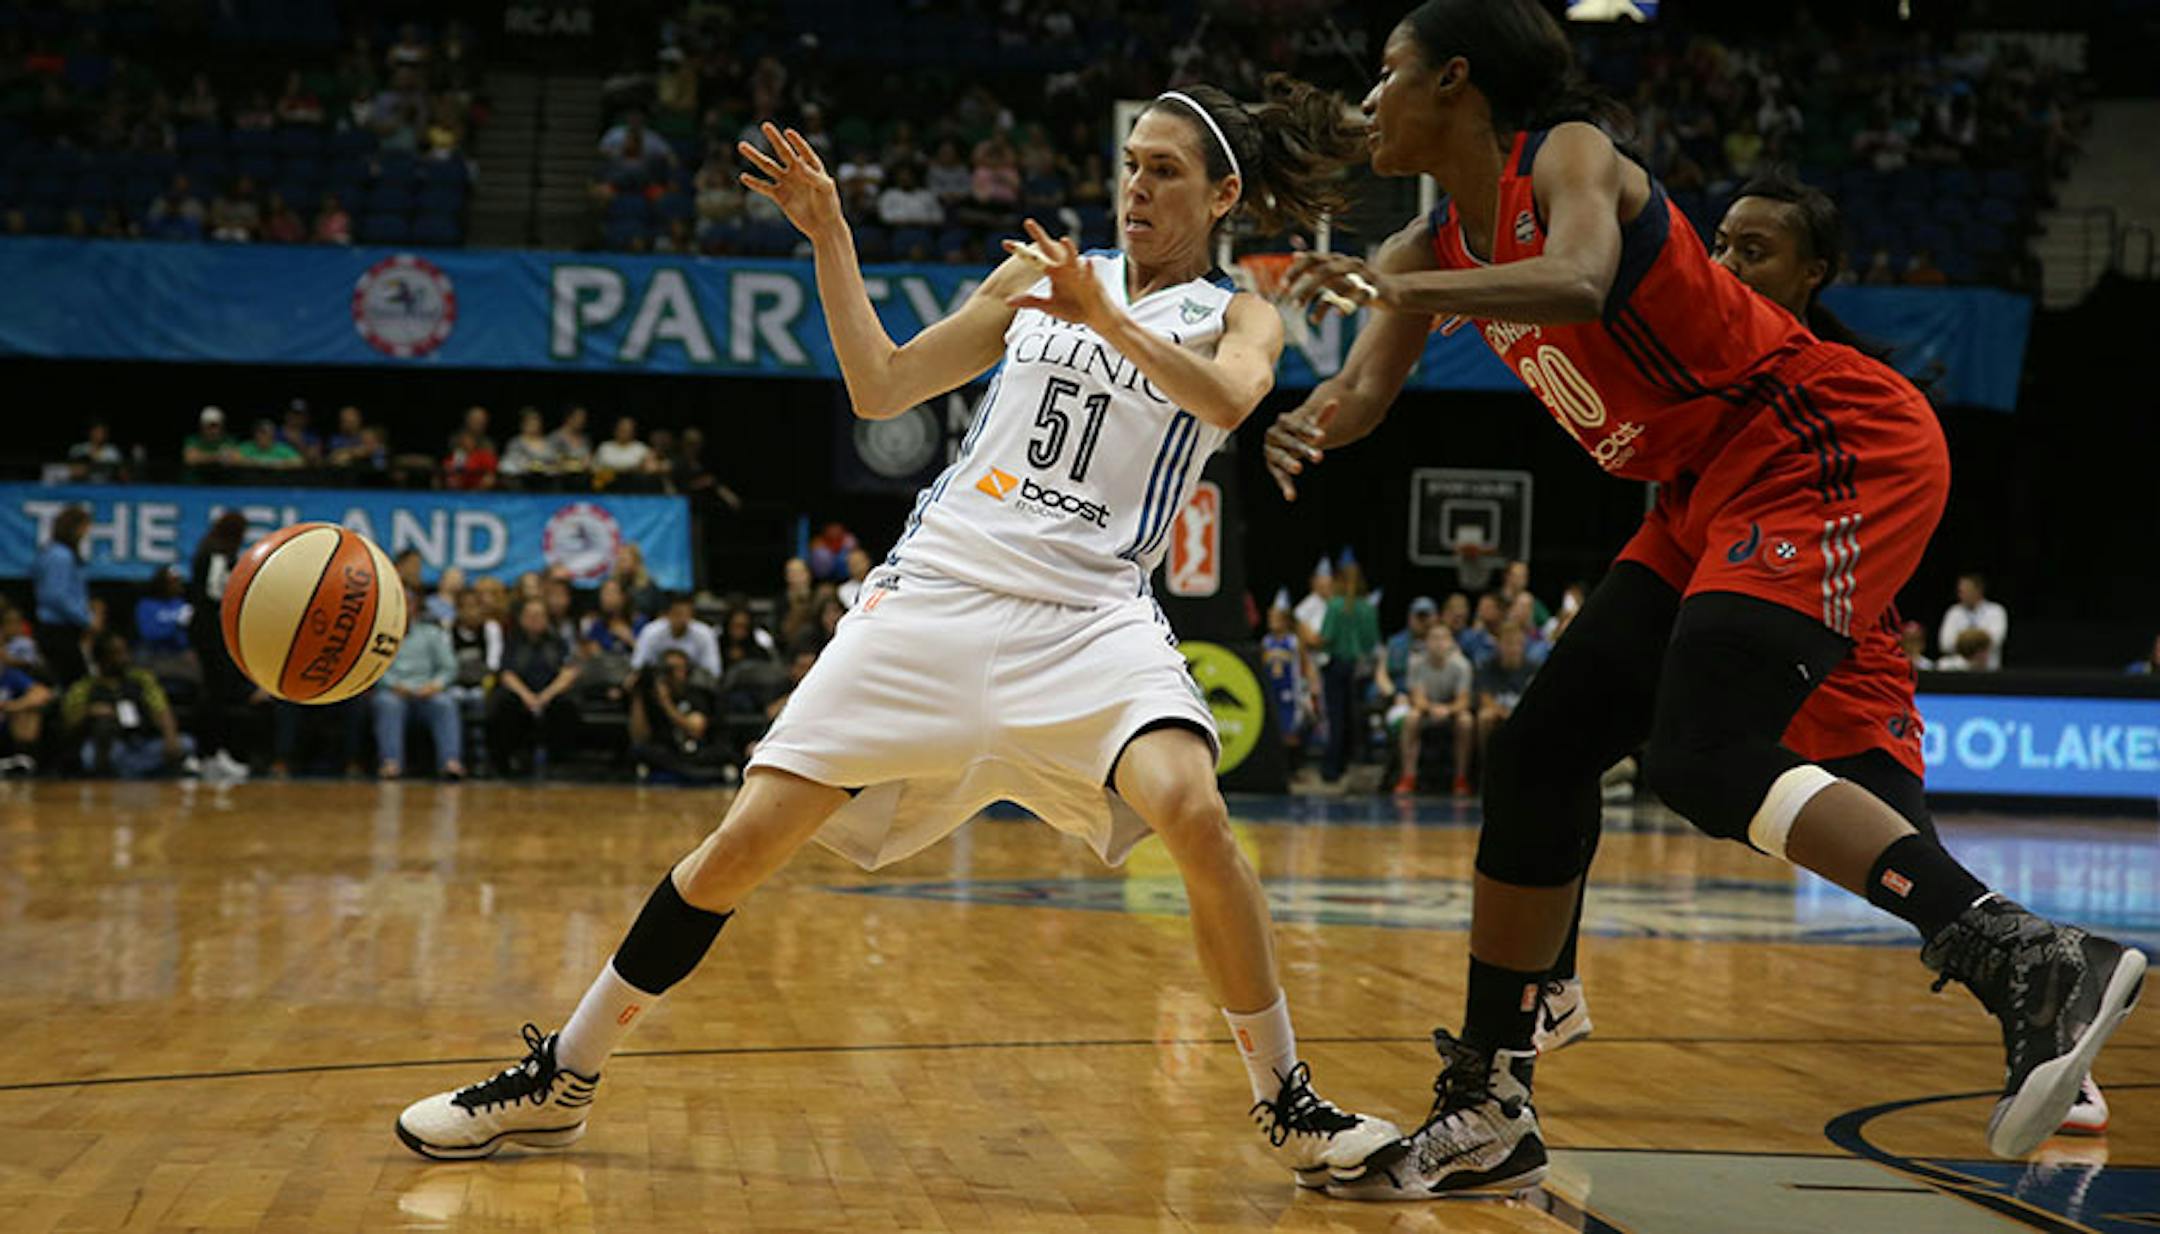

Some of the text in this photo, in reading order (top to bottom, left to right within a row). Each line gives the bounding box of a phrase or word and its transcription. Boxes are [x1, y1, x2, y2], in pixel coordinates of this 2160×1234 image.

[551, 265, 985, 365] PARY
[1027, 375, 1111, 482] 51
[1021, 478, 1110, 528] boost
[301, 565, 372, 687] SPALDING
[1955, 717, 2160, 771] O'LAKE
